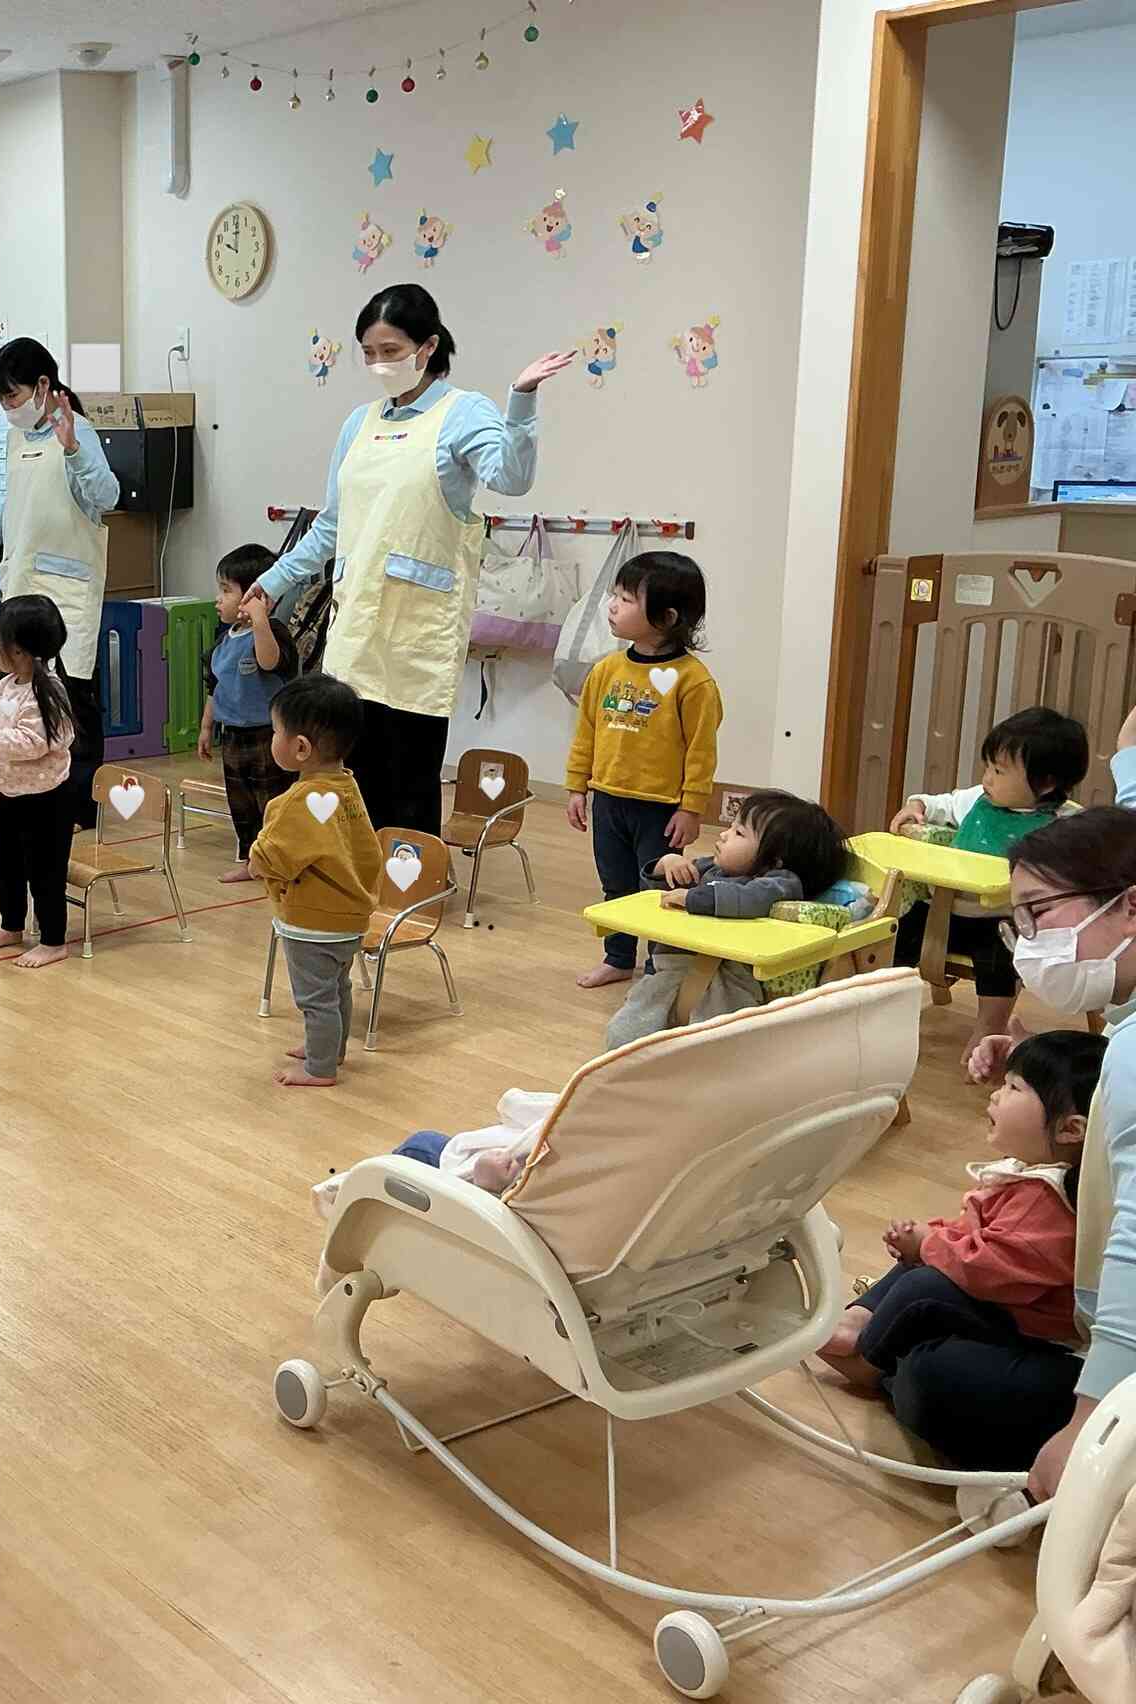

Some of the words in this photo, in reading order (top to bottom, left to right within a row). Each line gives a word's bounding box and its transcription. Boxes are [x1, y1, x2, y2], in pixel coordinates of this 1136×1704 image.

[251, 225, 257, 237] 2
[217, 234, 224, 246] 10
[254, 241, 260, 253] 3
[215, 250, 220, 261] 9
[217, 265, 223, 275] 8
[235, 276, 241, 288] 6
